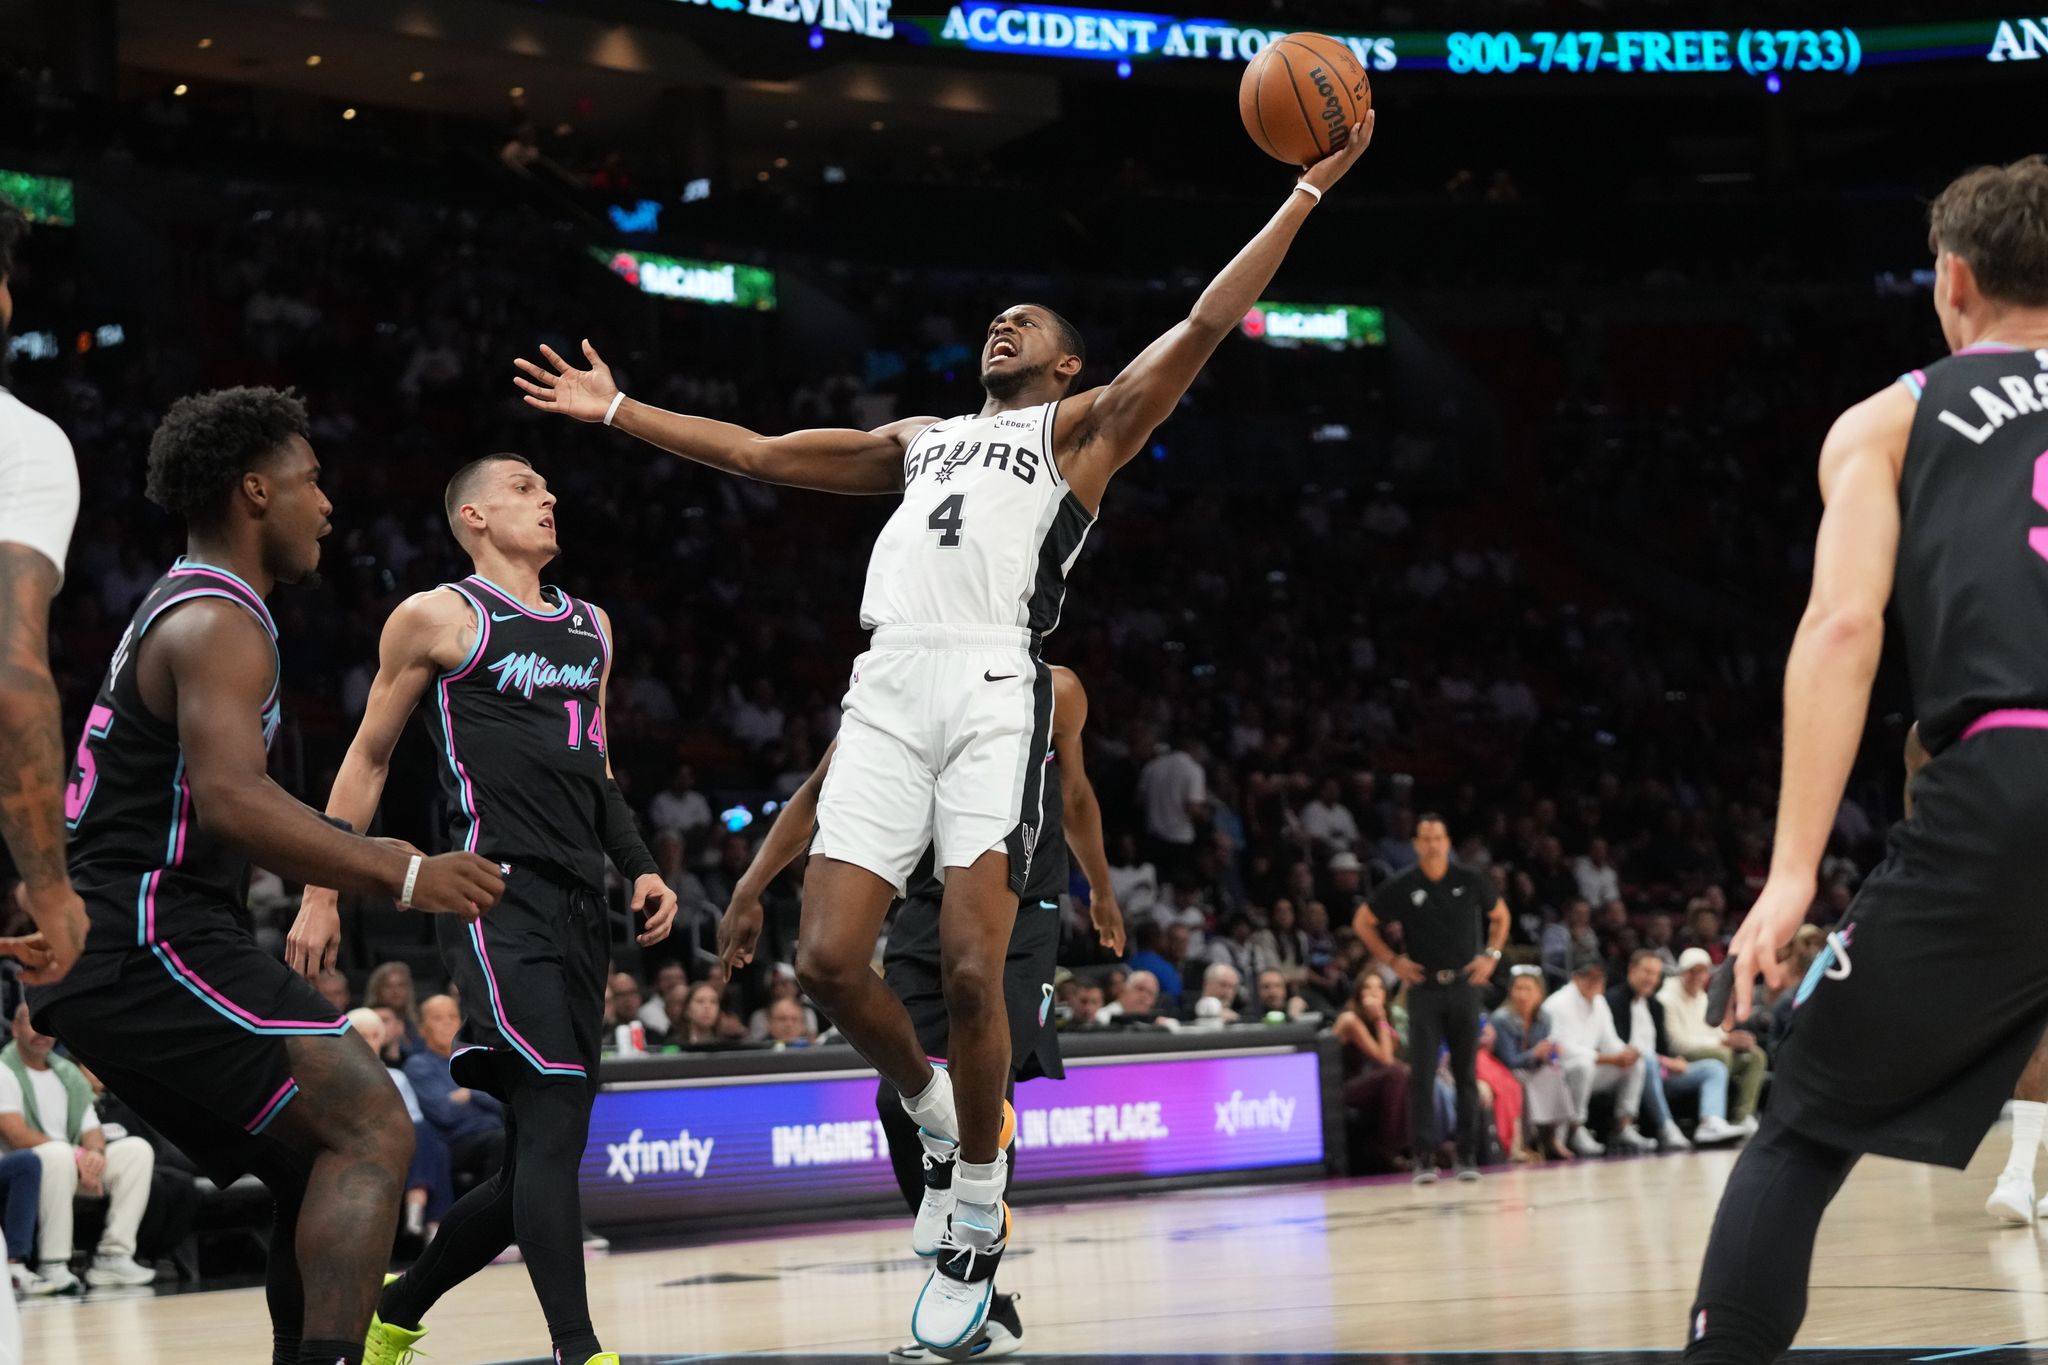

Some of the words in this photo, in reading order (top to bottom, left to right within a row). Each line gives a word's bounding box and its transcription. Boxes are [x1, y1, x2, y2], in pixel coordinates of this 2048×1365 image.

[941, 5, 1158, 54] ACCIDENT
[1162, 22, 1398, 71] ATTOYS
[1447, 30, 1733, 74] 800-747-FREE
[1736, 27, 1861, 76] (3733)
[1000, 419, 1031, 429] LEDGER
[905, 440, 1040, 486] SPURS
[926, 492, 968, 549] 4
[487, 651, 600, 700] Miami
[563, 700, 605, 757] 14
[771, 1120, 865, 1168] IMAGINE
[1022, 1109, 1048, 1148] IN
[1049, 1106, 1094, 1148] ONE
[1094, 1101, 1169, 1143] PLACE.
[1213, 1089, 1297, 1137] xfinity
[606, 1128, 714, 1183] xfinity
